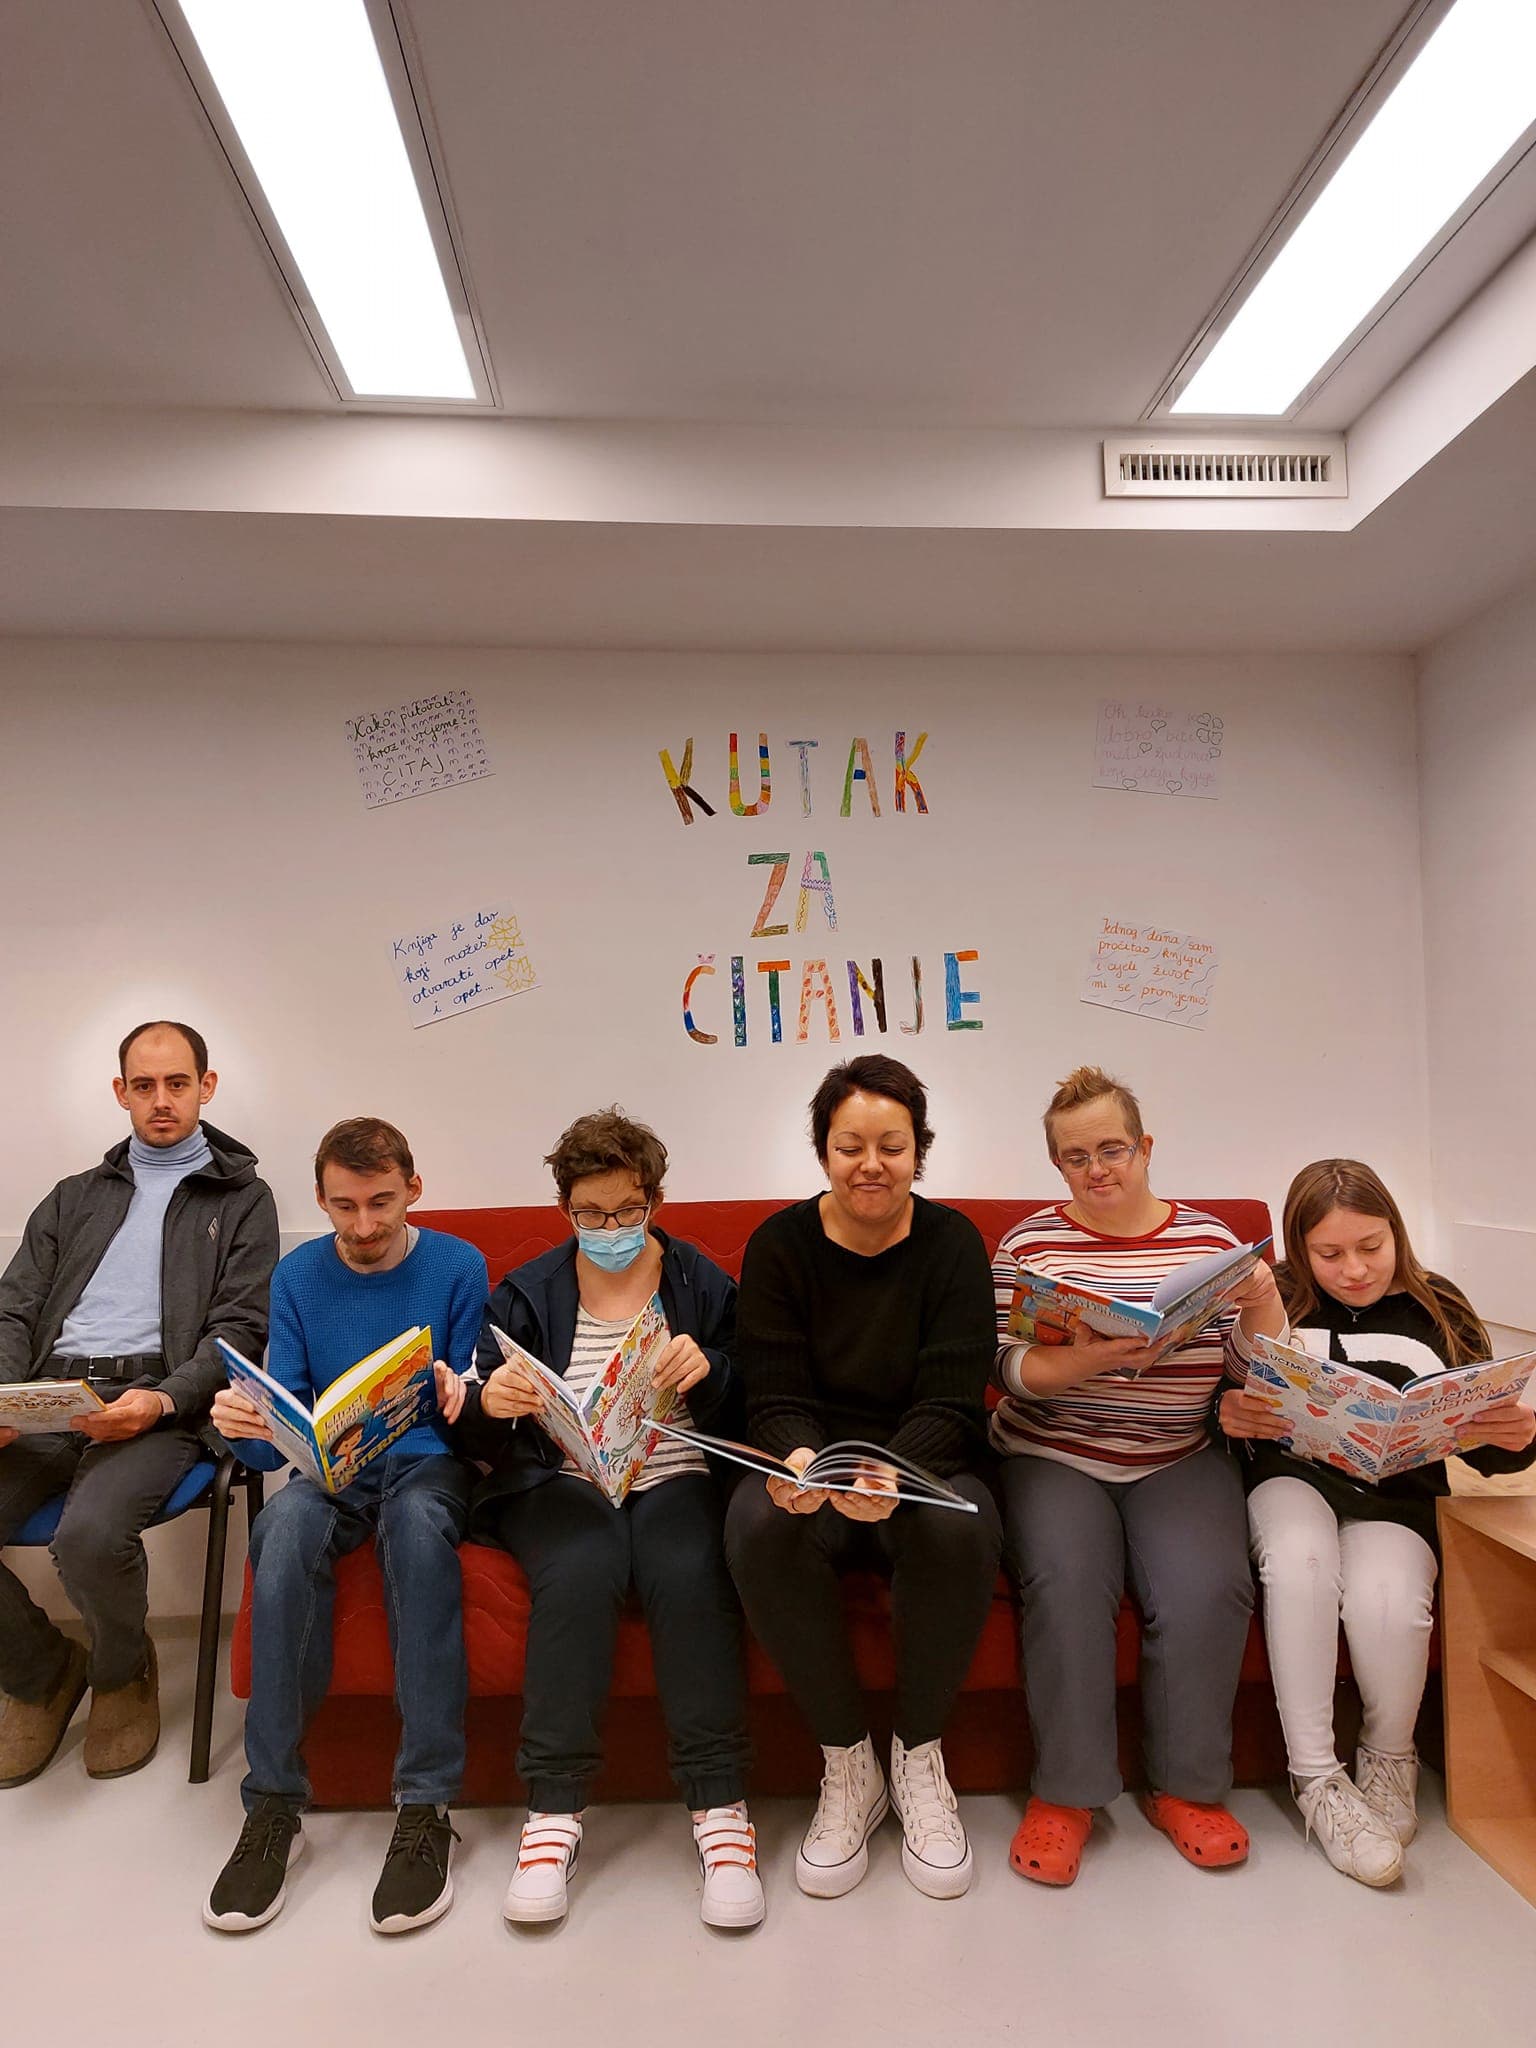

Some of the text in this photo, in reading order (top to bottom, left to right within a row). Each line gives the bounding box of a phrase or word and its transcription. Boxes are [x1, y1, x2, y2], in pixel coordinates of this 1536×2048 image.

[353, 695, 454, 742] Kako putovati
[366, 708, 468, 762] kroz vrijeme?
[382, 753, 445, 787] ČITAJ
[658, 731, 929, 826] KUTAK
[747, 850, 839, 938] ZA
[392, 911, 499, 960] Knjiga je dar
[403, 934, 487, 983] koji možeš
[1147, 930, 1181, 945] dana
[1187, 940, 1214, 954] sam
[412, 948, 515, 1004] otvarati opet
[682, 950, 984, 1047] ČITANJE
[1091, 980, 1108, 989] mi
[1117, 982, 1132, 993] se
[432, 1001, 442, 1015] i
